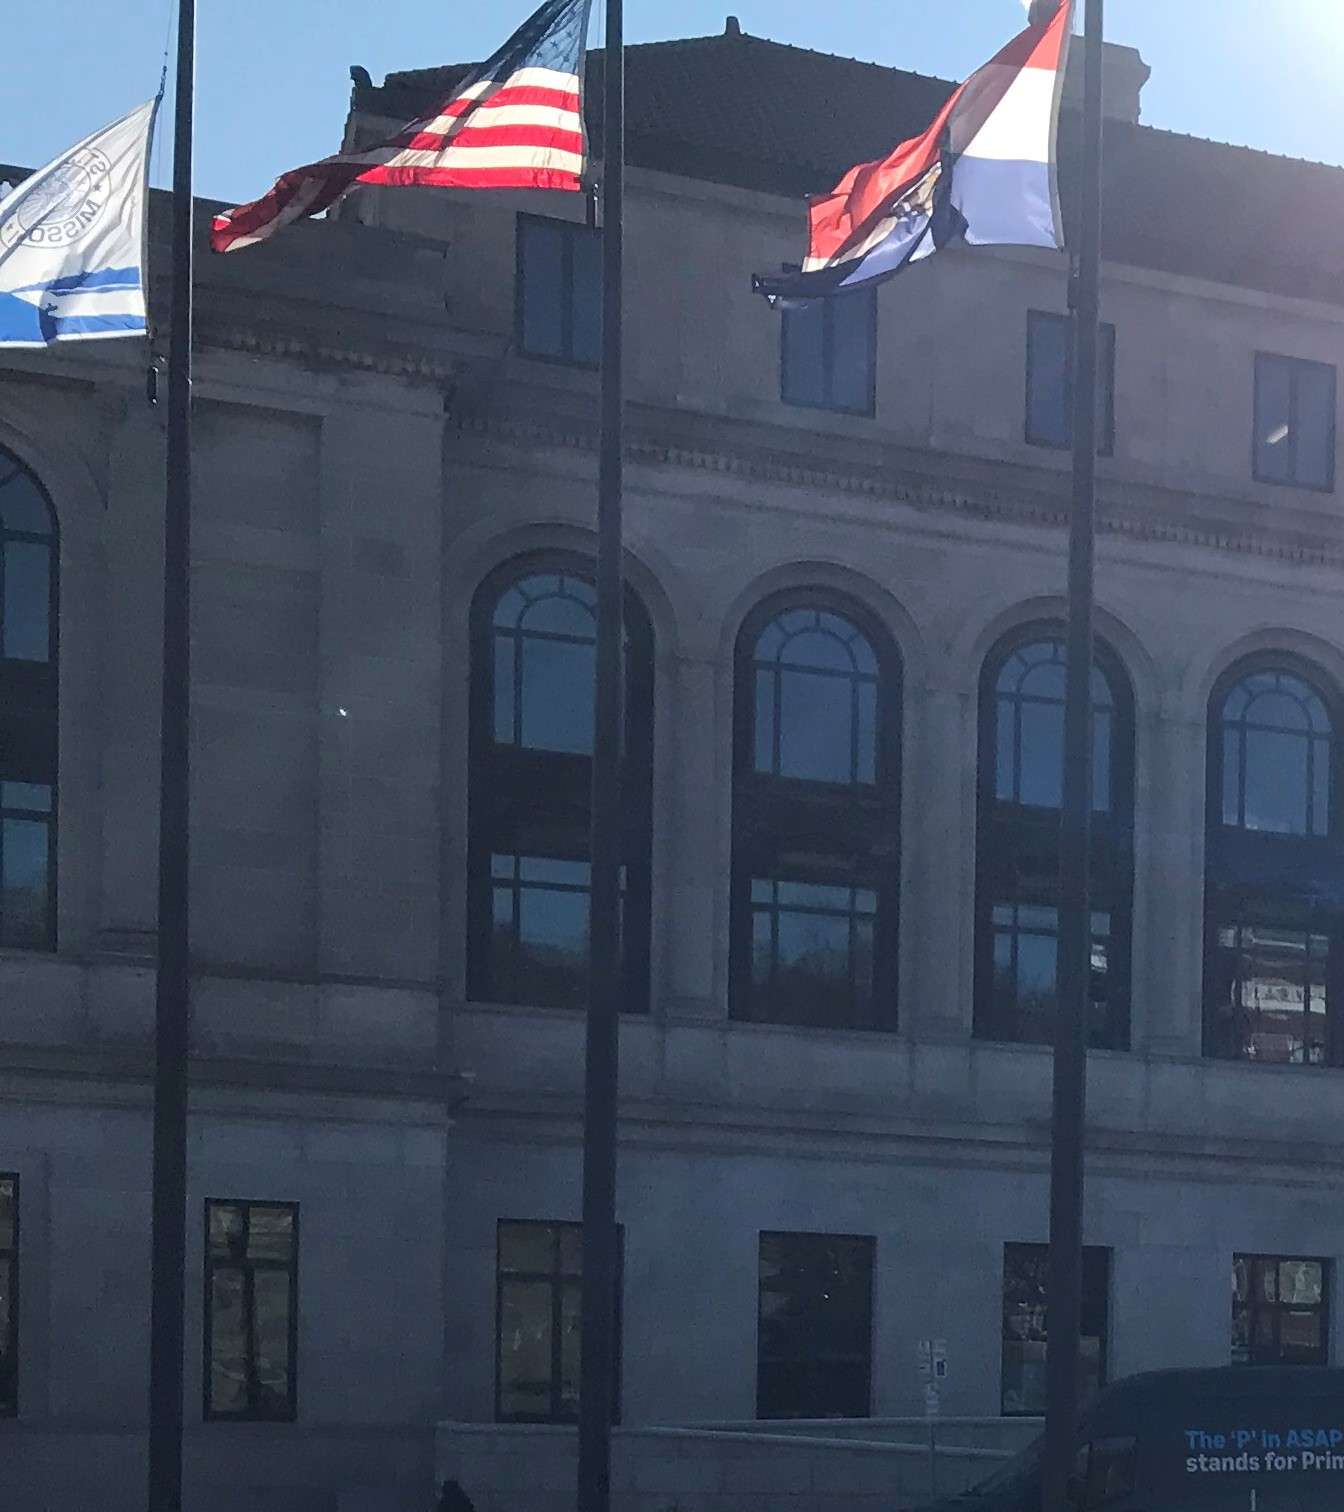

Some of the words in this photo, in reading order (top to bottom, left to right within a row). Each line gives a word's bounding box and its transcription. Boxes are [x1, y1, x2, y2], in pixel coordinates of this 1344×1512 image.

[1186, 1430, 1225, 1449] The
[1262, 1430, 1280, 1448] in
[1287, 1428, 1343, 1448] ASAP
[1186, 1452, 1260, 1472] stands
[1265, 1451, 1297, 1471] for
